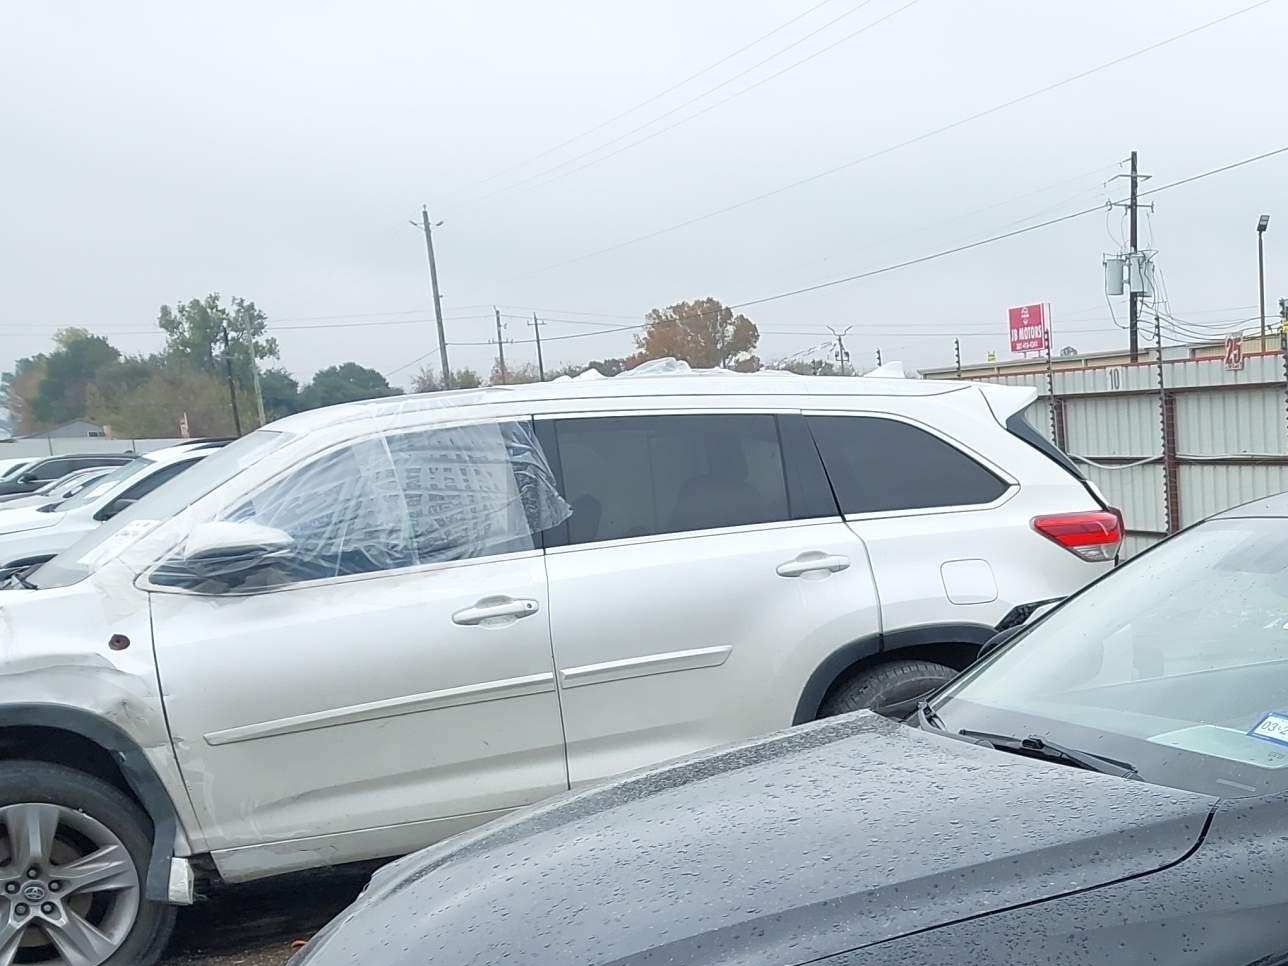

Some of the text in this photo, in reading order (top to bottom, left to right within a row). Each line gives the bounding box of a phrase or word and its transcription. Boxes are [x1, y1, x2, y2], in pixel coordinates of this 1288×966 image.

[1018, 325, 1042, 340] MOTORS
[1226, 336, 1242, 365] 25
[1109, 368, 1120, 390] 10
